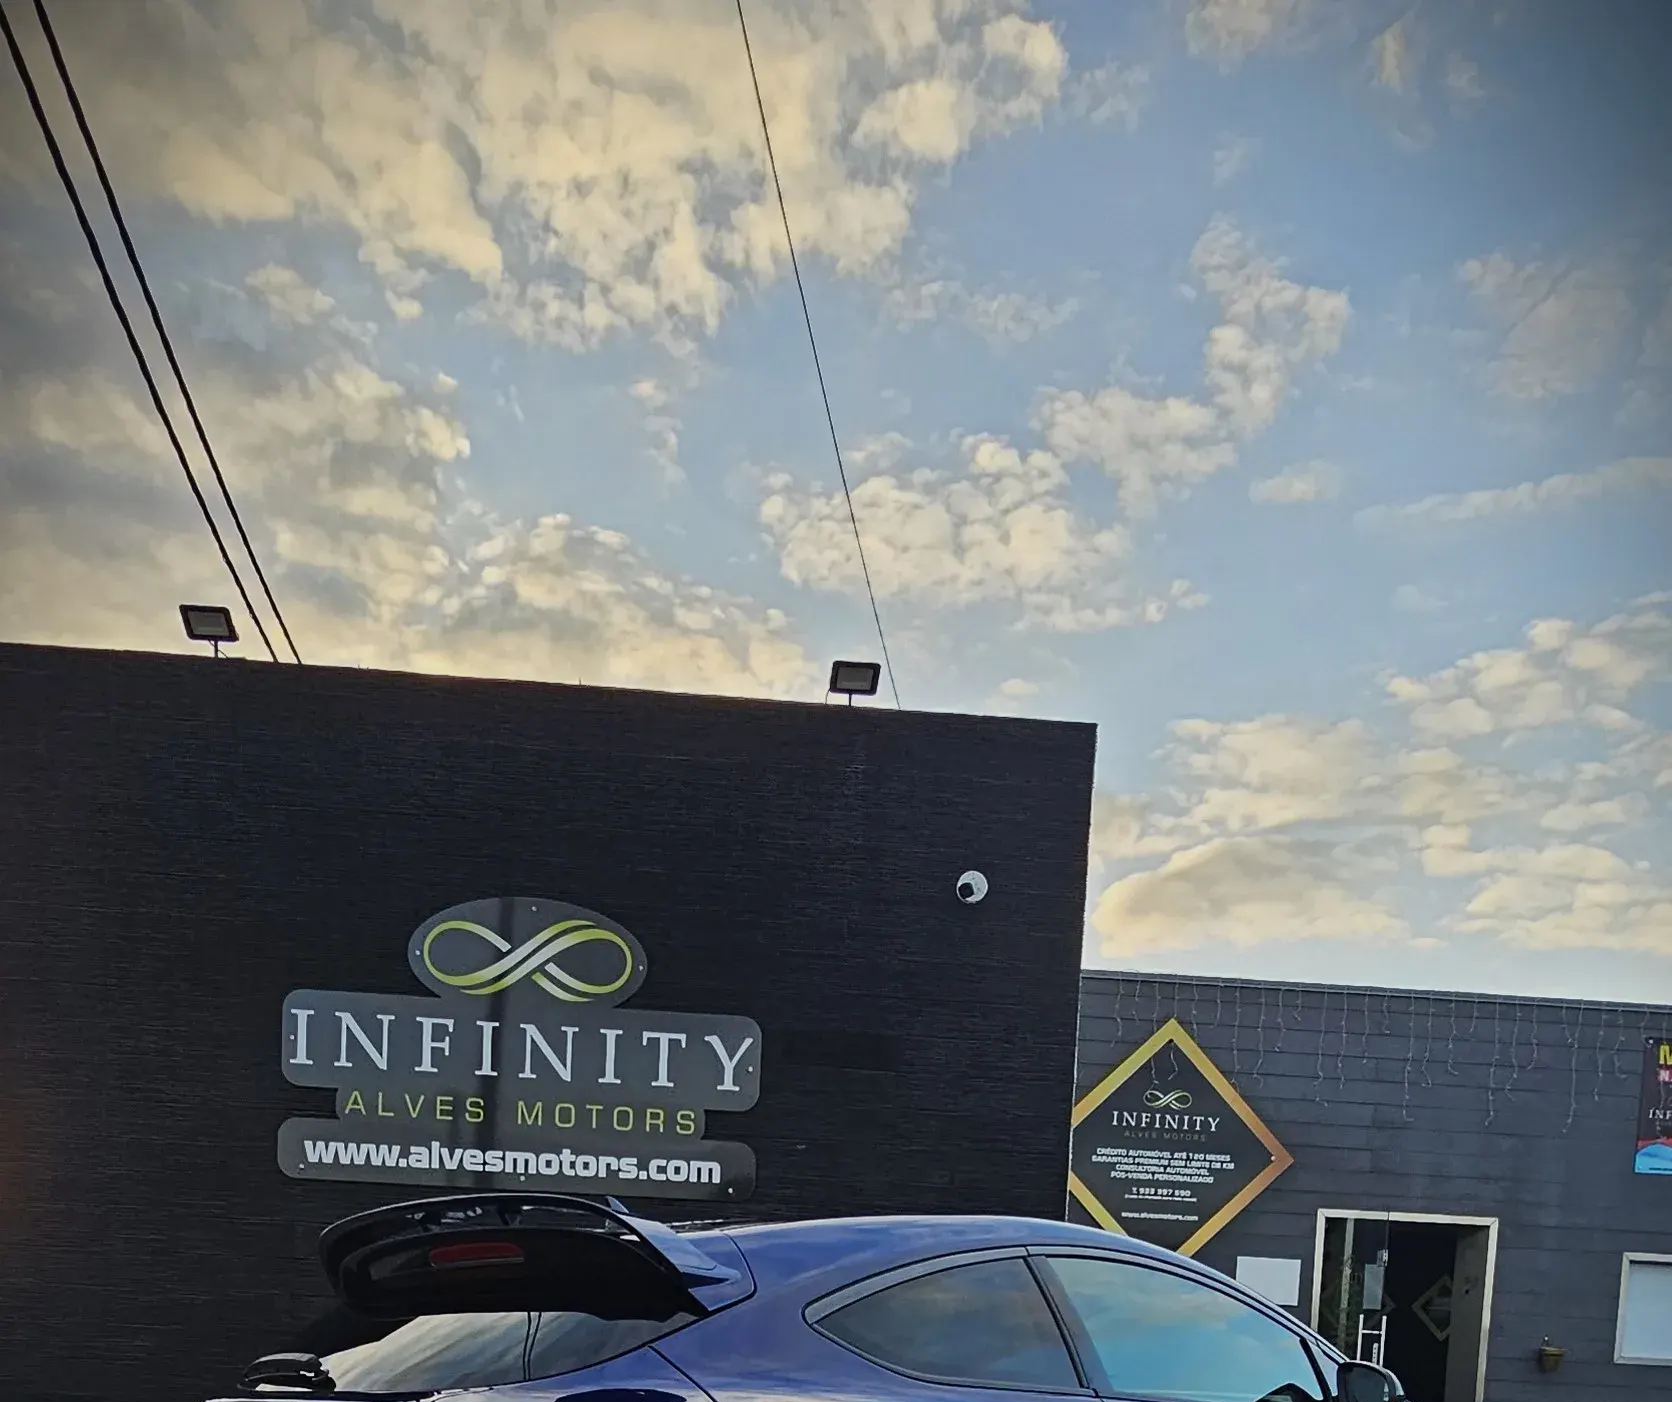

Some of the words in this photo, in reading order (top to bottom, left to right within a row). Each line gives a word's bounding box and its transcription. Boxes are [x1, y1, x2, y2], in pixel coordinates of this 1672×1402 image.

[289, 1007, 754, 1092] INFINITY
[343, 1090, 486, 1123] ALVES
[517, 1100, 696, 1135] MOTORS
[1111, 1111, 1220, 1132] INFINITY
[1124, 1130, 1157, 1140] ALVES
[1163, 1132, 1206, 1142] MOTORS
[303, 1139, 722, 1184] www.alvesmotors.com
